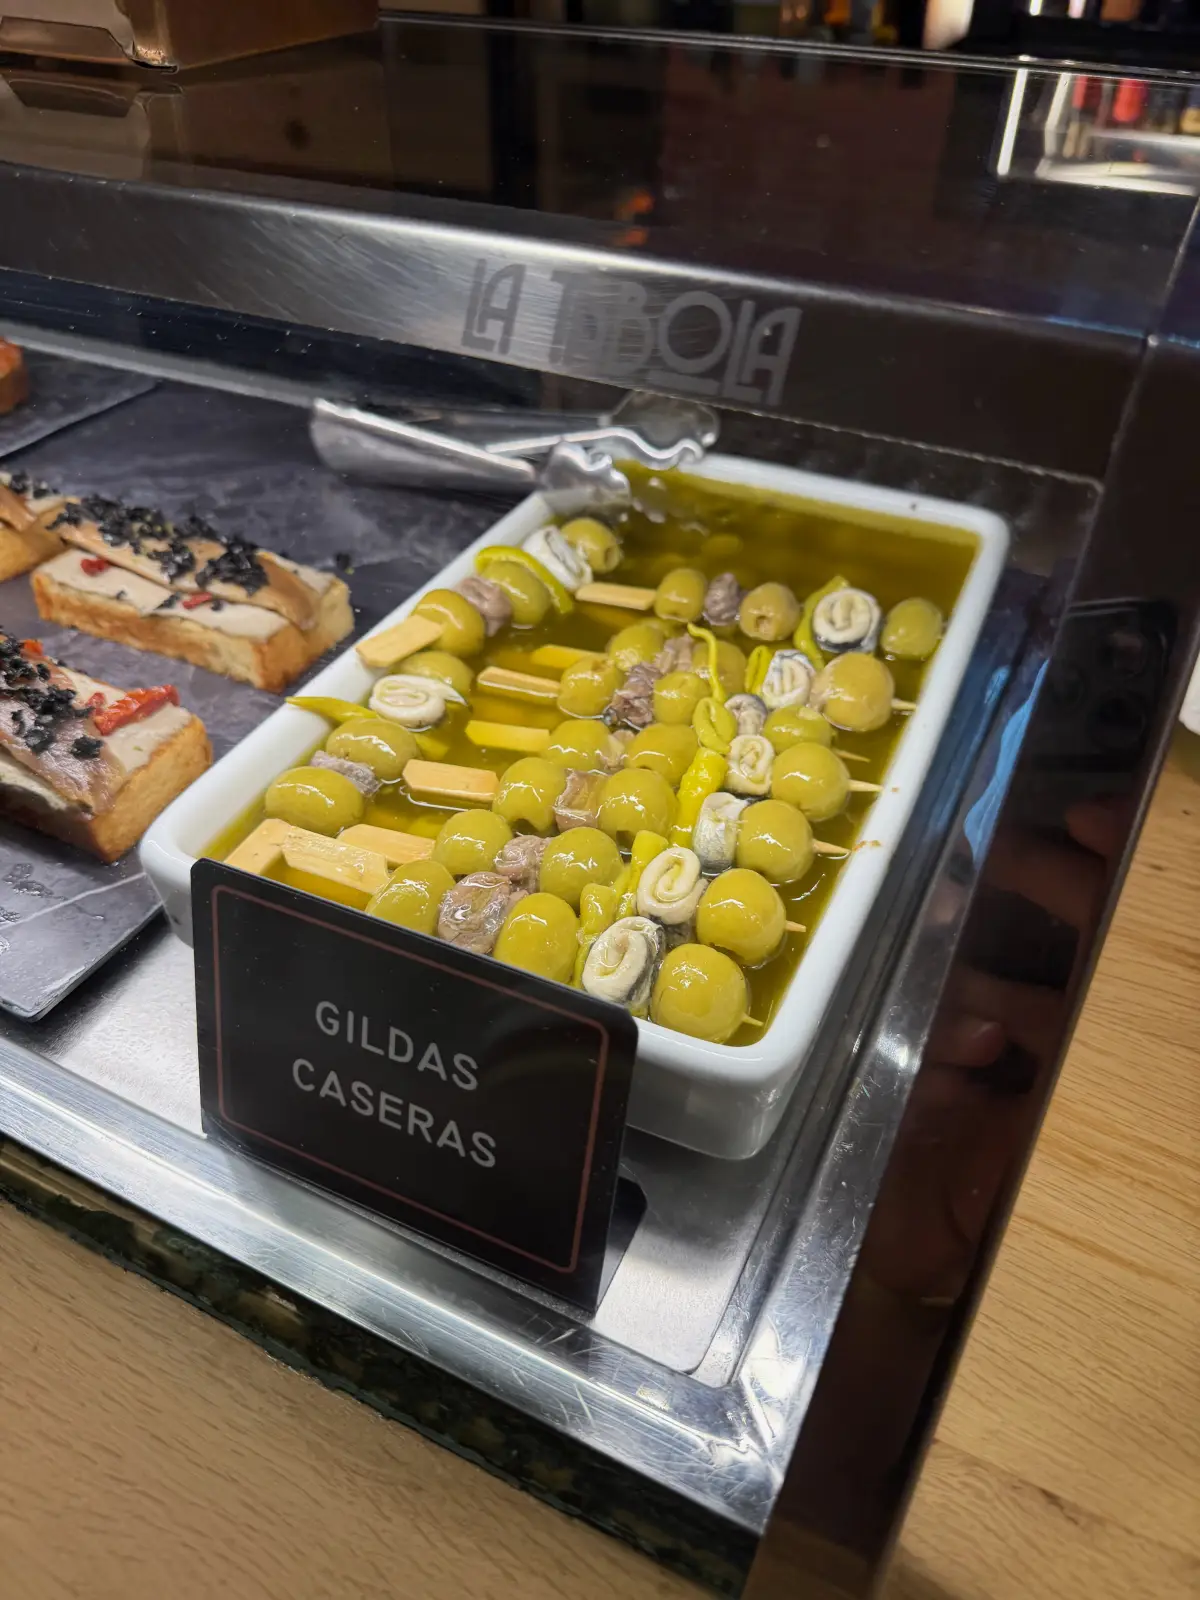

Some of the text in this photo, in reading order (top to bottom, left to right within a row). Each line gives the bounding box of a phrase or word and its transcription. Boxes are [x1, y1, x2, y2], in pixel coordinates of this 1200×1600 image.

[461, 257, 527, 356] LA
[315, 1000, 479, 1091] GILDAS
[292, 1058, 497, 1168] CASERAS
